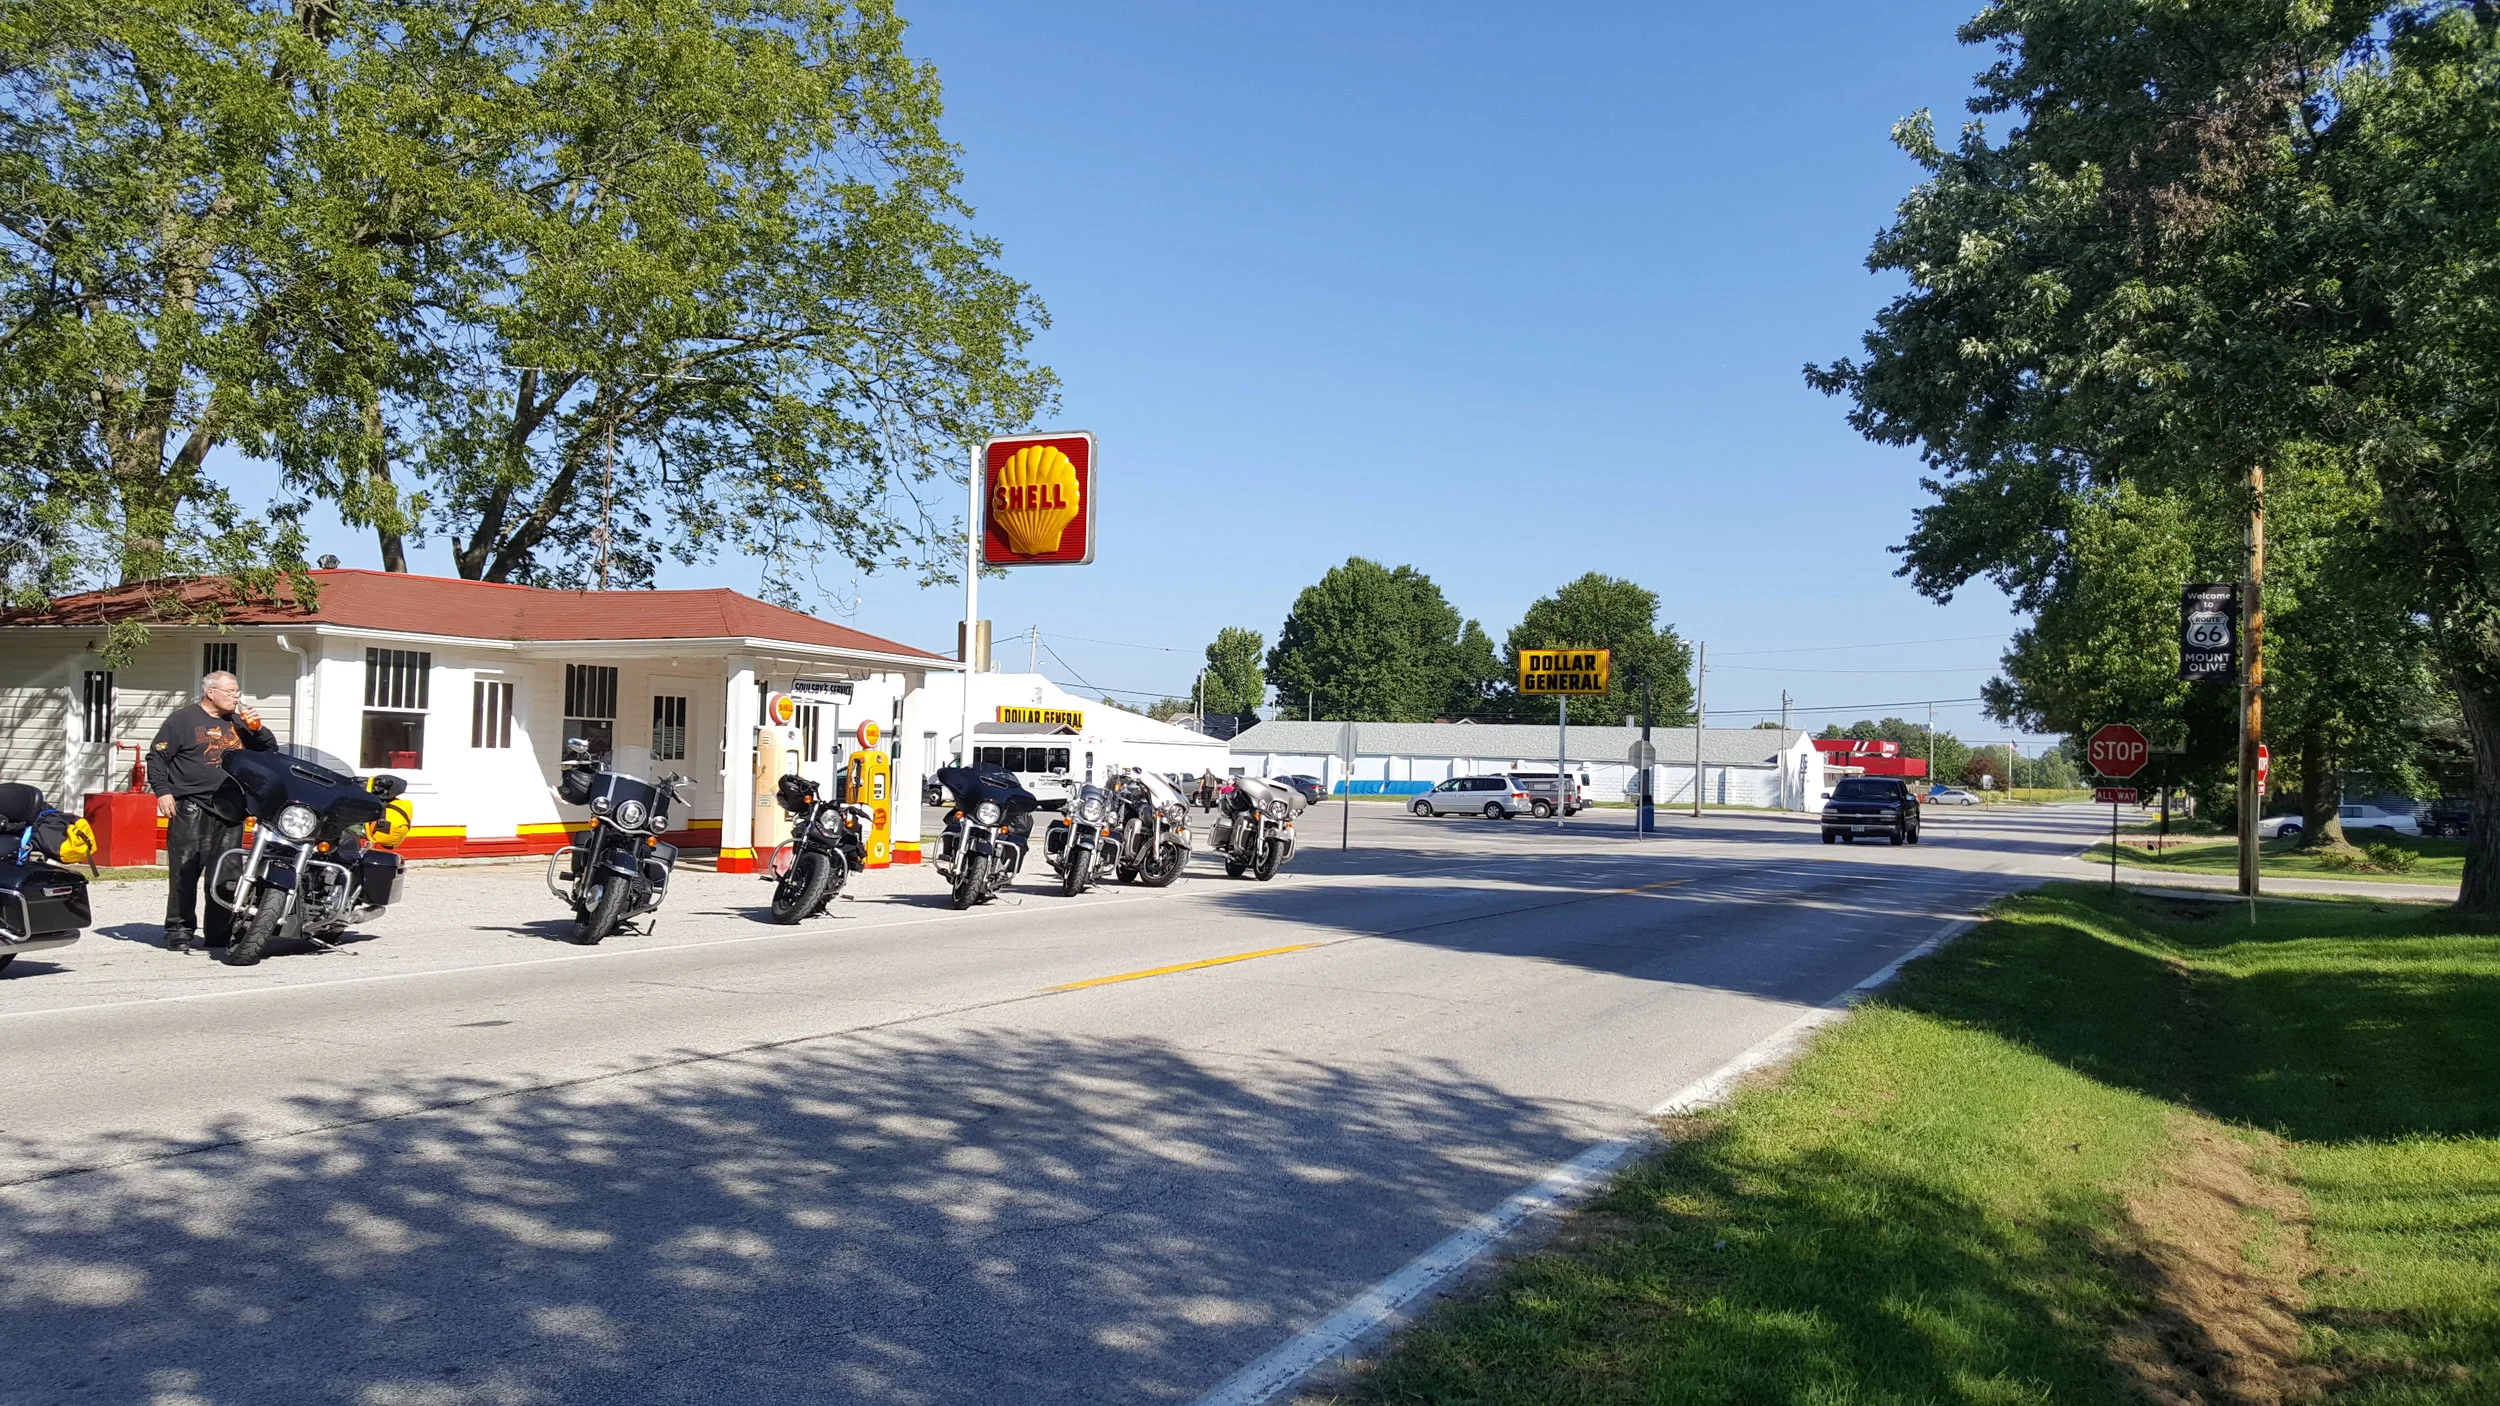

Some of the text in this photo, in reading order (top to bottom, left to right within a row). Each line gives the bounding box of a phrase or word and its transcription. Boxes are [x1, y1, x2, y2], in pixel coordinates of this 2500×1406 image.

[996, 484, 1067, 511] SHELL
[2187, 592, 2231, 600] Welcome
[2194, 625, 2223, 642] 66
[1530, 655, 1596, 671] DOLLAR
[2185, 653, 2231, 662] MOUNT
[2189, 663, 2227, 672] OLIVE
[794, 682, 853, 696] SOULSBY'S SERVICE
[1525, 674, 1601, 690] GENERAL
[779, 704, 794, 712] SHELL
[1004, 708, 1083, 728] DOLLAR GENERAL
[2092, 741, 2144, 761] STOP
[2097, 791, 2136, 801] ALL WAY
